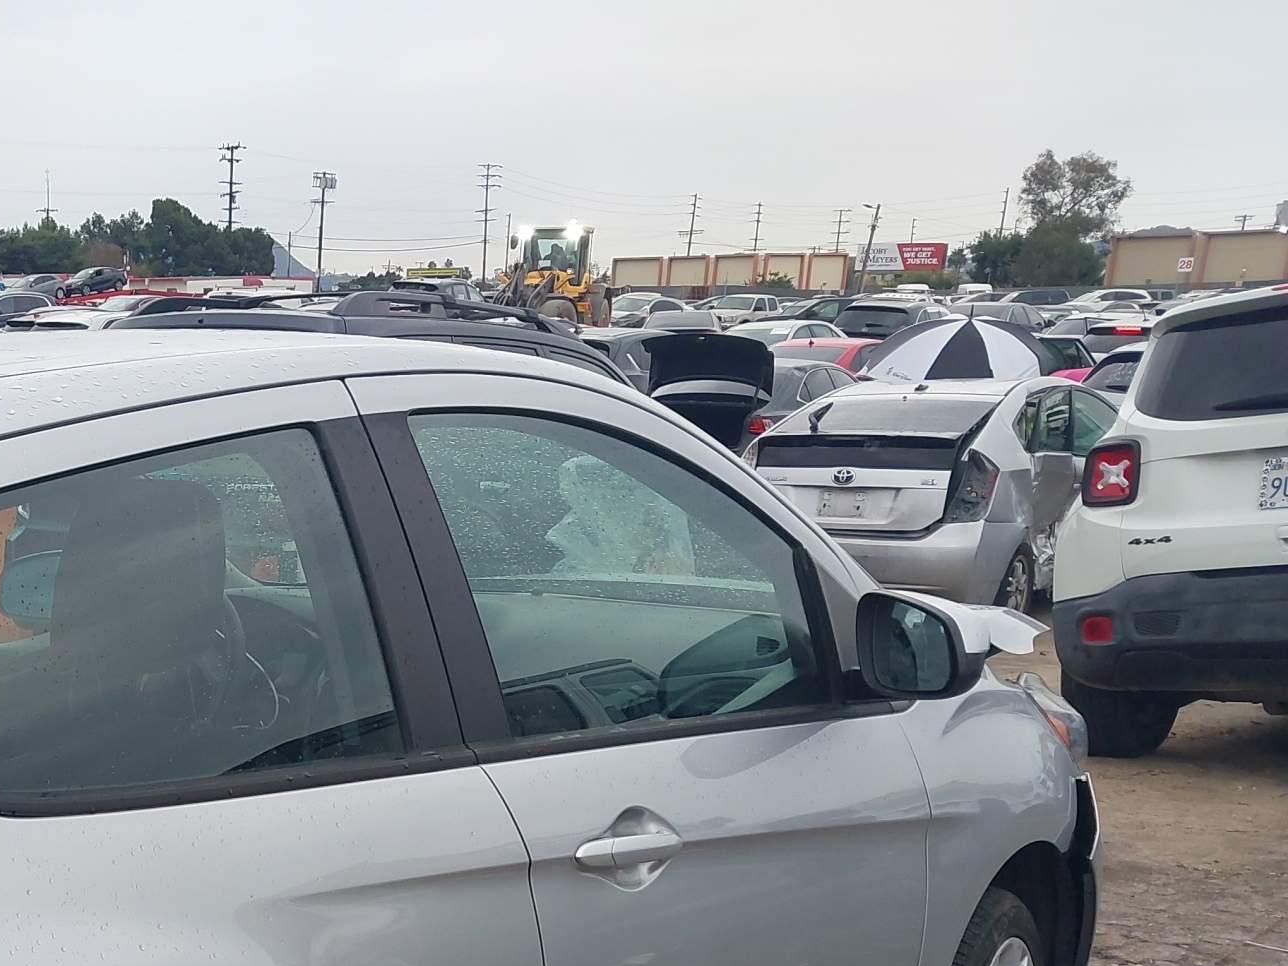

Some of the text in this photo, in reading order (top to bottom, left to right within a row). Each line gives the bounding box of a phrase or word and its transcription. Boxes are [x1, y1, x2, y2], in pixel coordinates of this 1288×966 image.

[860, 246, 888, 255] JCOBY
[866, 254, 898, 263] MEYERS
[1179, 260, 1192, 269] 28
[1128, 535, 1173, 545] 4x4
